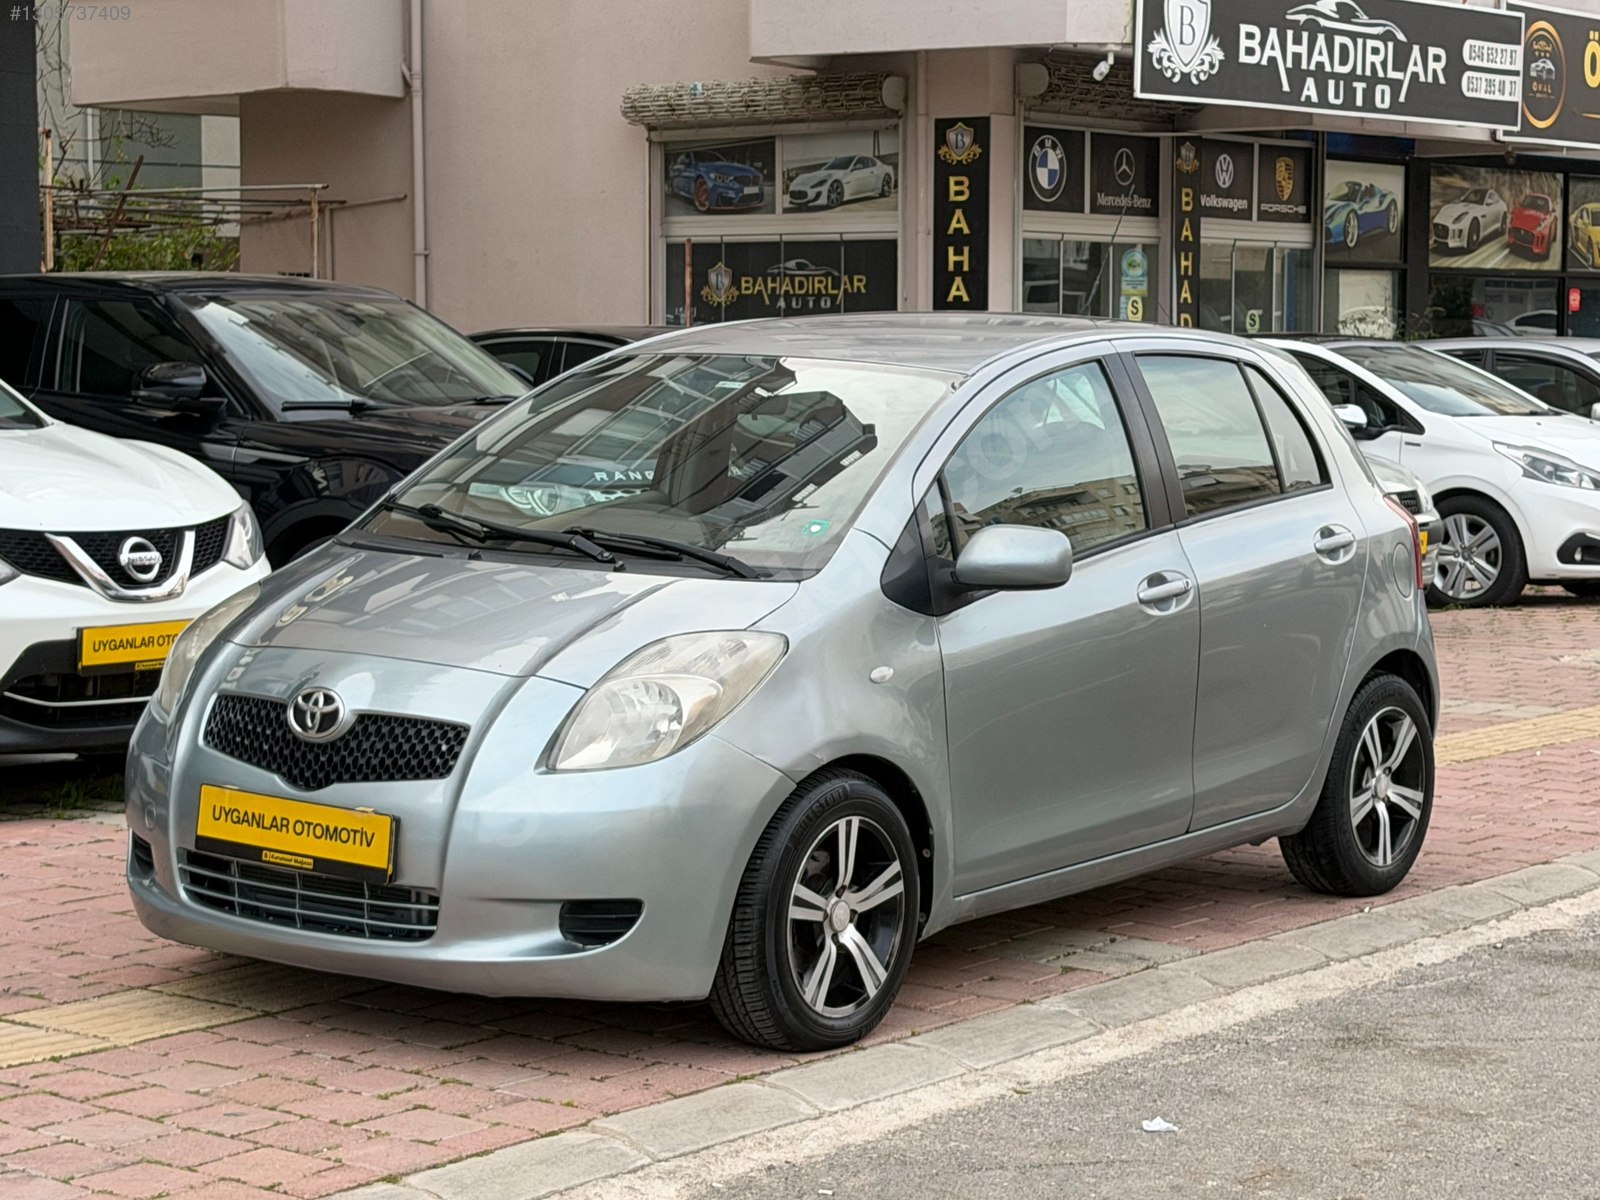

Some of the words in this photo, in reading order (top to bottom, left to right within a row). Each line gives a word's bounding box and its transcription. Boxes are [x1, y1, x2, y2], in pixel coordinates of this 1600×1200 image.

[1179, 5, 1196, 46] B
[1238, 23, 1447, 103] BAHADIRLAR
[1300, 77, 1391, 109] AUTO
[1034, 139, 1064, 160] BMW
[1097, 192, 1152, 209] Mercedes-Benz
[1200, 193, 1248, 212] Volkswagen
[1260, 203, 1307, 214] PORSCHE
[741, 275, 867, 305] BAHADIRLAR
[776, 296, 831, 309] AUTO
[1130, 299, 1139, 316] S
[1248, 312, 1257, 328] S
[93, 636, 155, 652] UYGANLAR
[212, 804, 290, 834] UYGANLAR
[293, 819, 376, 848] OTOMOTİV
